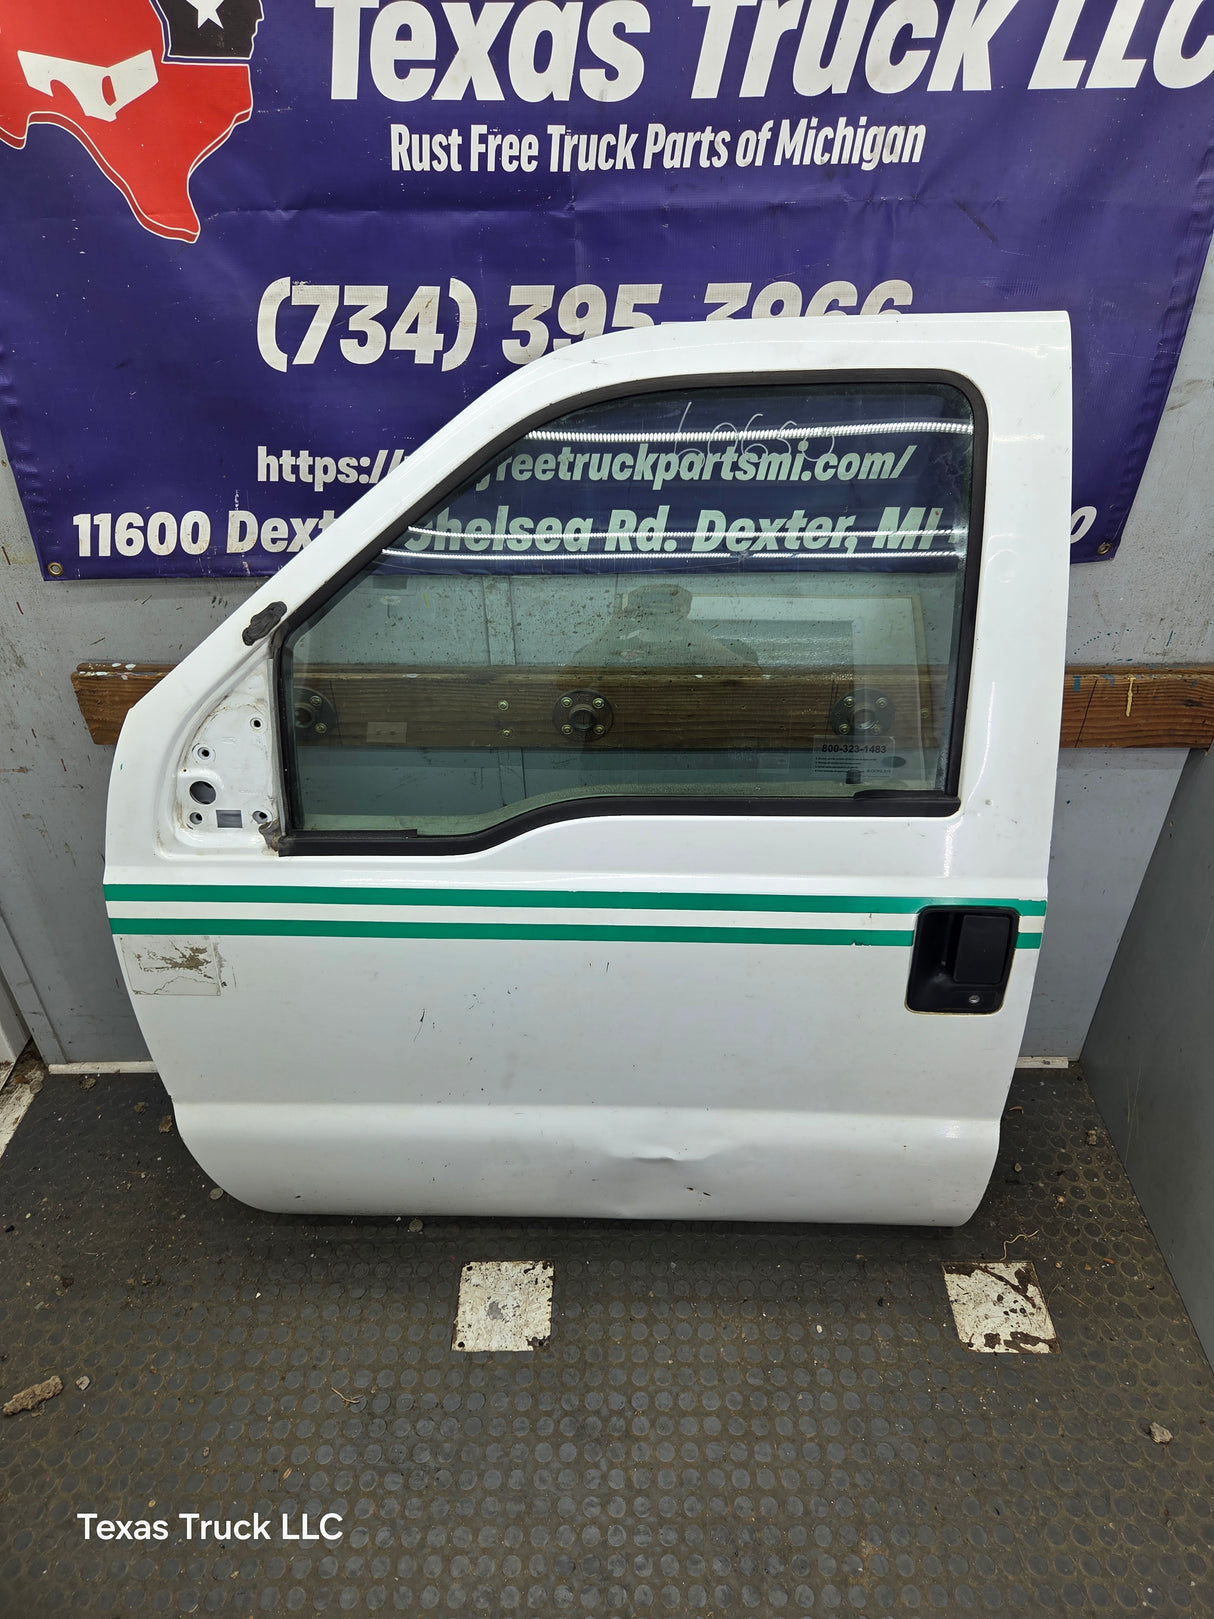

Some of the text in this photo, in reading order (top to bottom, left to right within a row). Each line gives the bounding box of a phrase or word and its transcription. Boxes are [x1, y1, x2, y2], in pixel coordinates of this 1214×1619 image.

[315, 0, 1214, 102] Texas Truck LLC
[389, 116, 927, 172] Rust Free Truck Parts of Michigan
[257, 277, 477, 372] (734)
[73, 510, 211, 557] 11600
[605, 505, 679, 552] Rd.
[692, 509, 857, 555] Dexter,
[872, 506, 943, 550] MI
[822, 744, 887, 754] 800-323-1483
